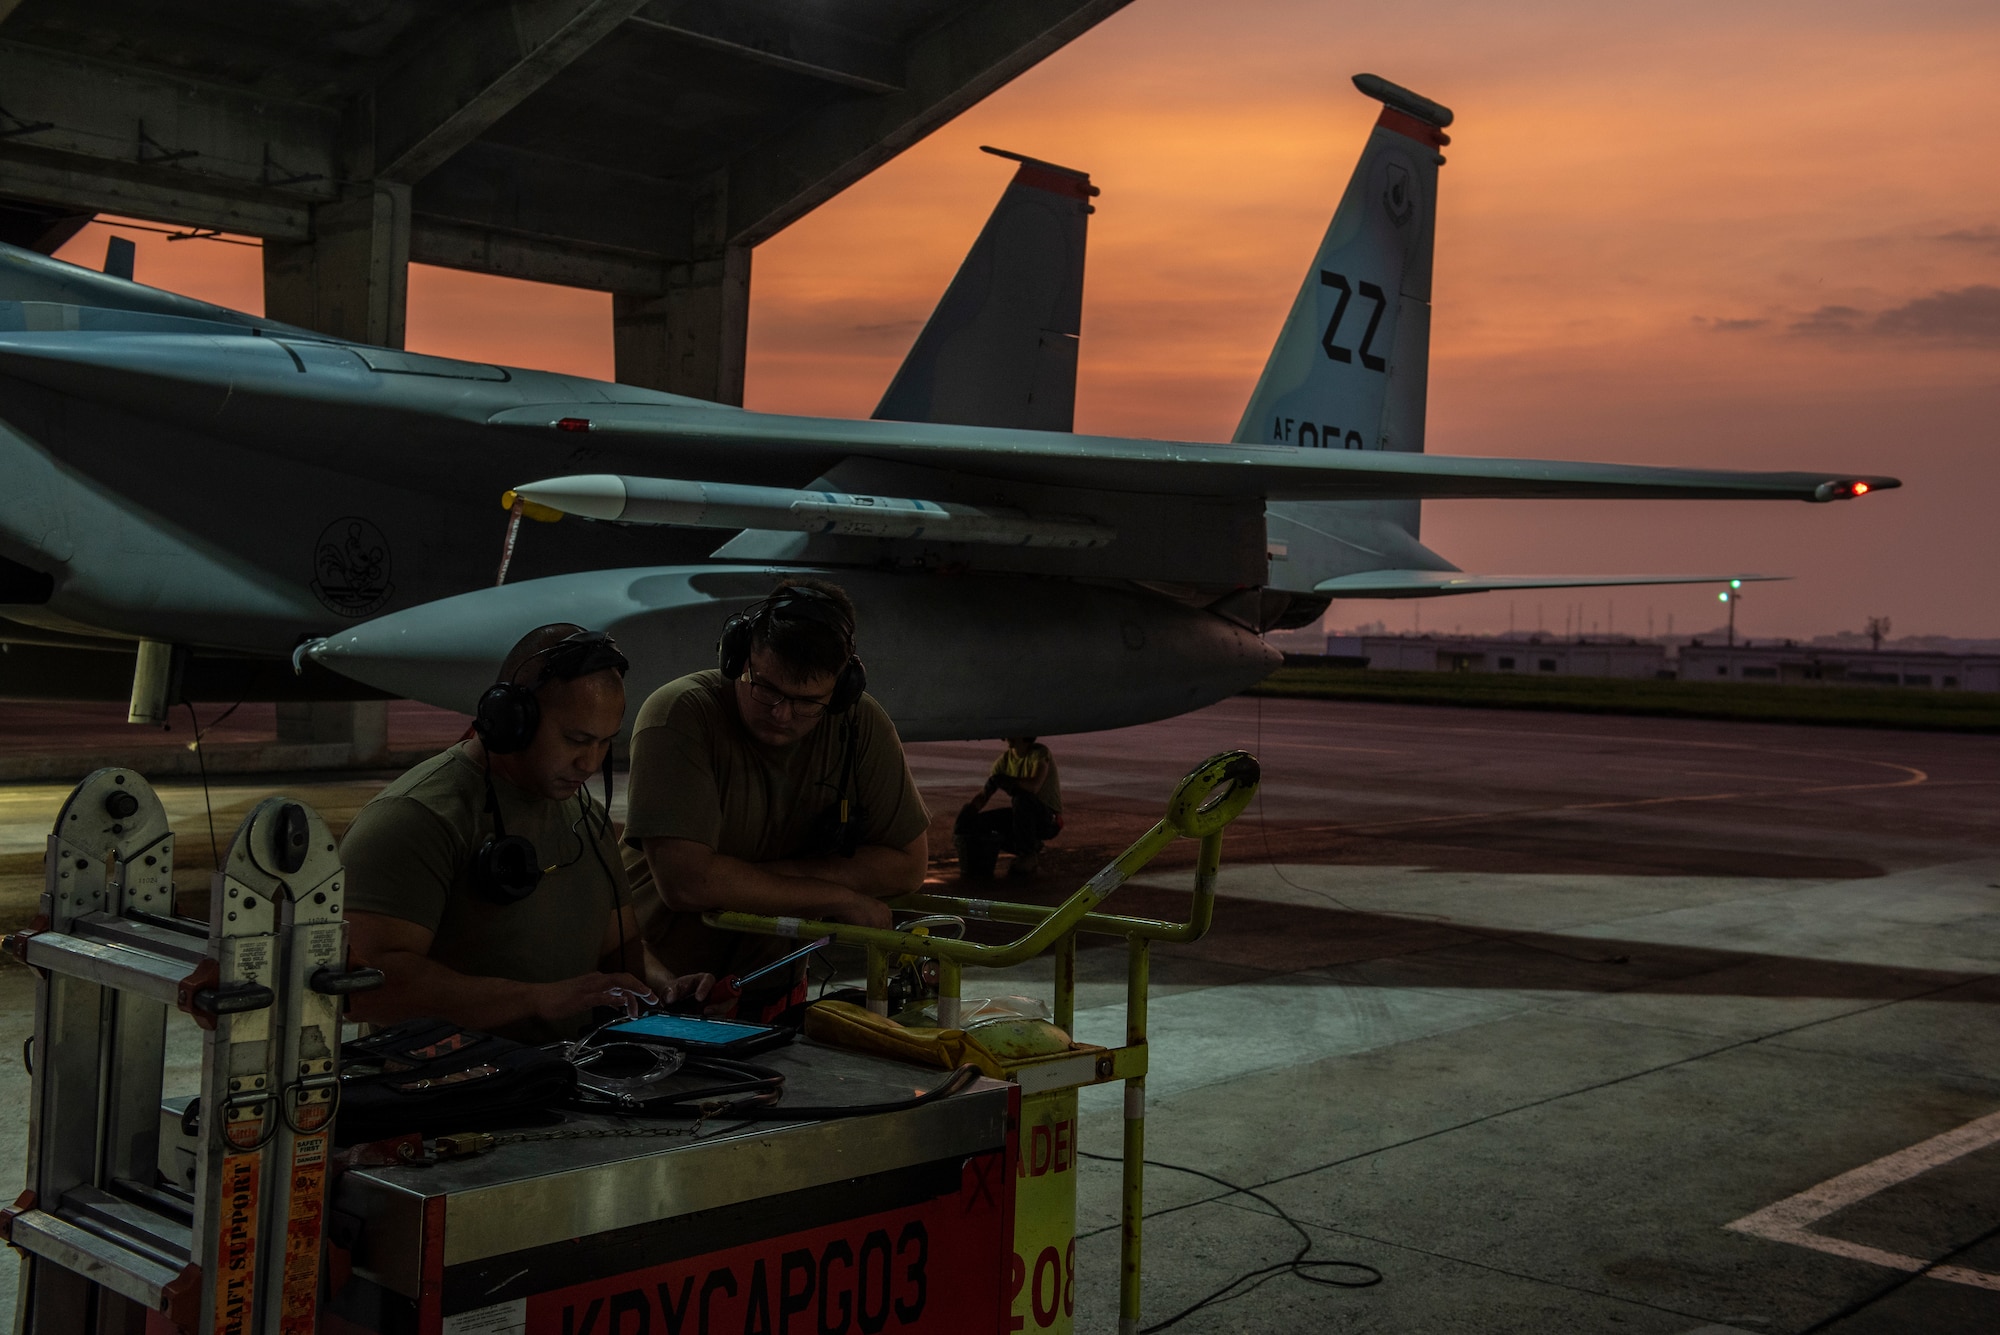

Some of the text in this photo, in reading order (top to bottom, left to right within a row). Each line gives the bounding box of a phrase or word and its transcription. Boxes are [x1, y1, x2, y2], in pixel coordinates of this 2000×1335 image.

[1321, 270, 1386, 373] ZZ
[1274, 416, 1294, 441] AF
[297, 1139, 323, 1148] SAFETY
[300, 1145, 320, 1153] FIRST
[297, 1155, 321, 1164] DANGER
[229, 1163, 251, 1271] SUPPORT
